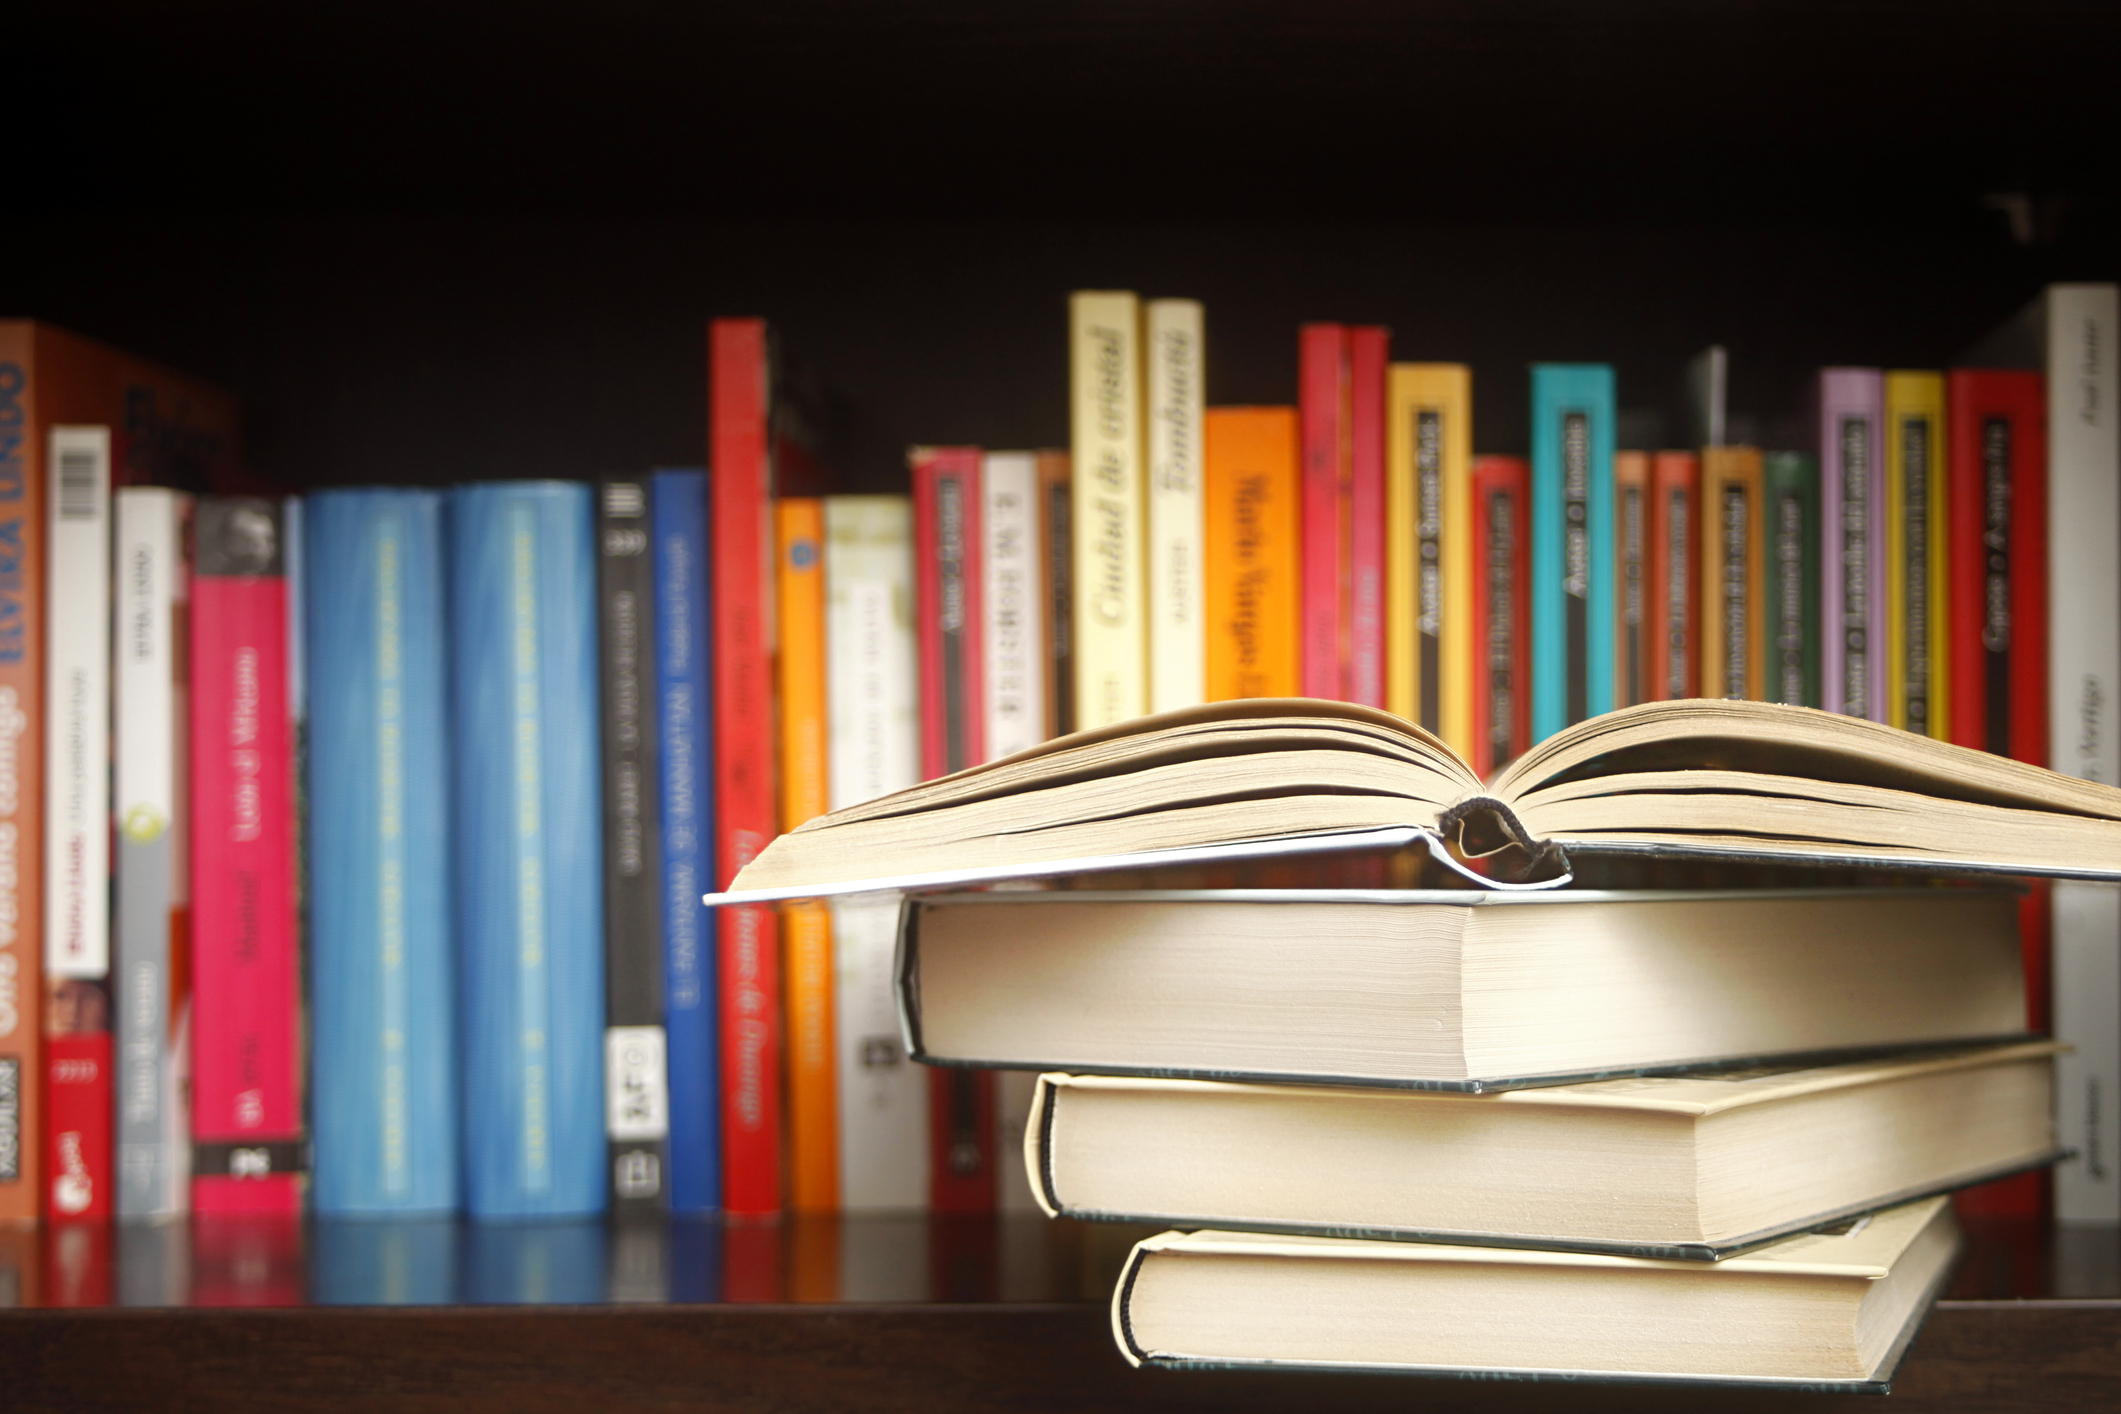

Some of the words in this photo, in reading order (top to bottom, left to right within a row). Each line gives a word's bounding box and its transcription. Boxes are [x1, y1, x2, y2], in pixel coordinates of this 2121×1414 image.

[1088, 324, 1126, 442] cristal
[1089, 446, 1126, 494] de
[1415, 419, 1441, 468] Park
[1562, 418, 1588, 500] Invisible
[1233, 470, 1270, 566] Mario
[1415, 469, 1443, 538] Sunset
[1983, 528, 2006, 551] A
[1090, 497, 1128, 629] Ciudad
[1416, 565, 1443, 636] Auster
[1563, 525, 1588, 598] Auster
[1227, 567, 1268, 672] Vargas
[1983, 572, 2010, 652] Capote
[665, 682, 695, 822] MANHATTAN
